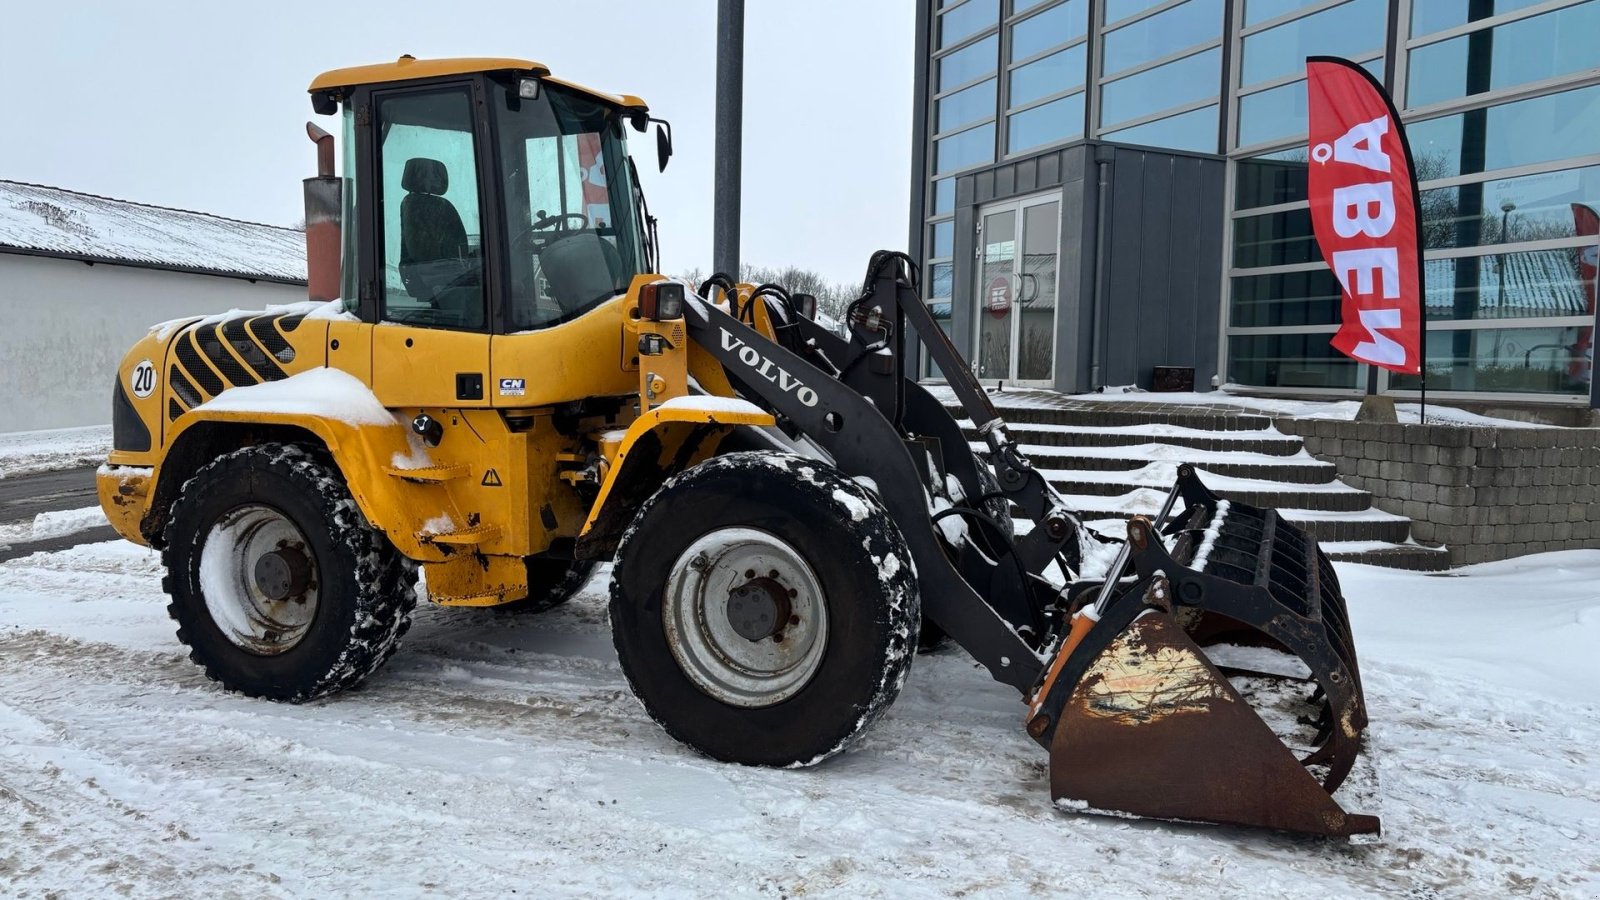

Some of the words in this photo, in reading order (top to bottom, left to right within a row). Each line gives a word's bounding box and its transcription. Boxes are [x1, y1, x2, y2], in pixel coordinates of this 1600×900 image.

[1312, 115, 1406, 365] ÅBEN
[135, 366, 153, 392] 20
[501, 379, 523, 388] CN
[719, 326, 819, 407] VOLVO
